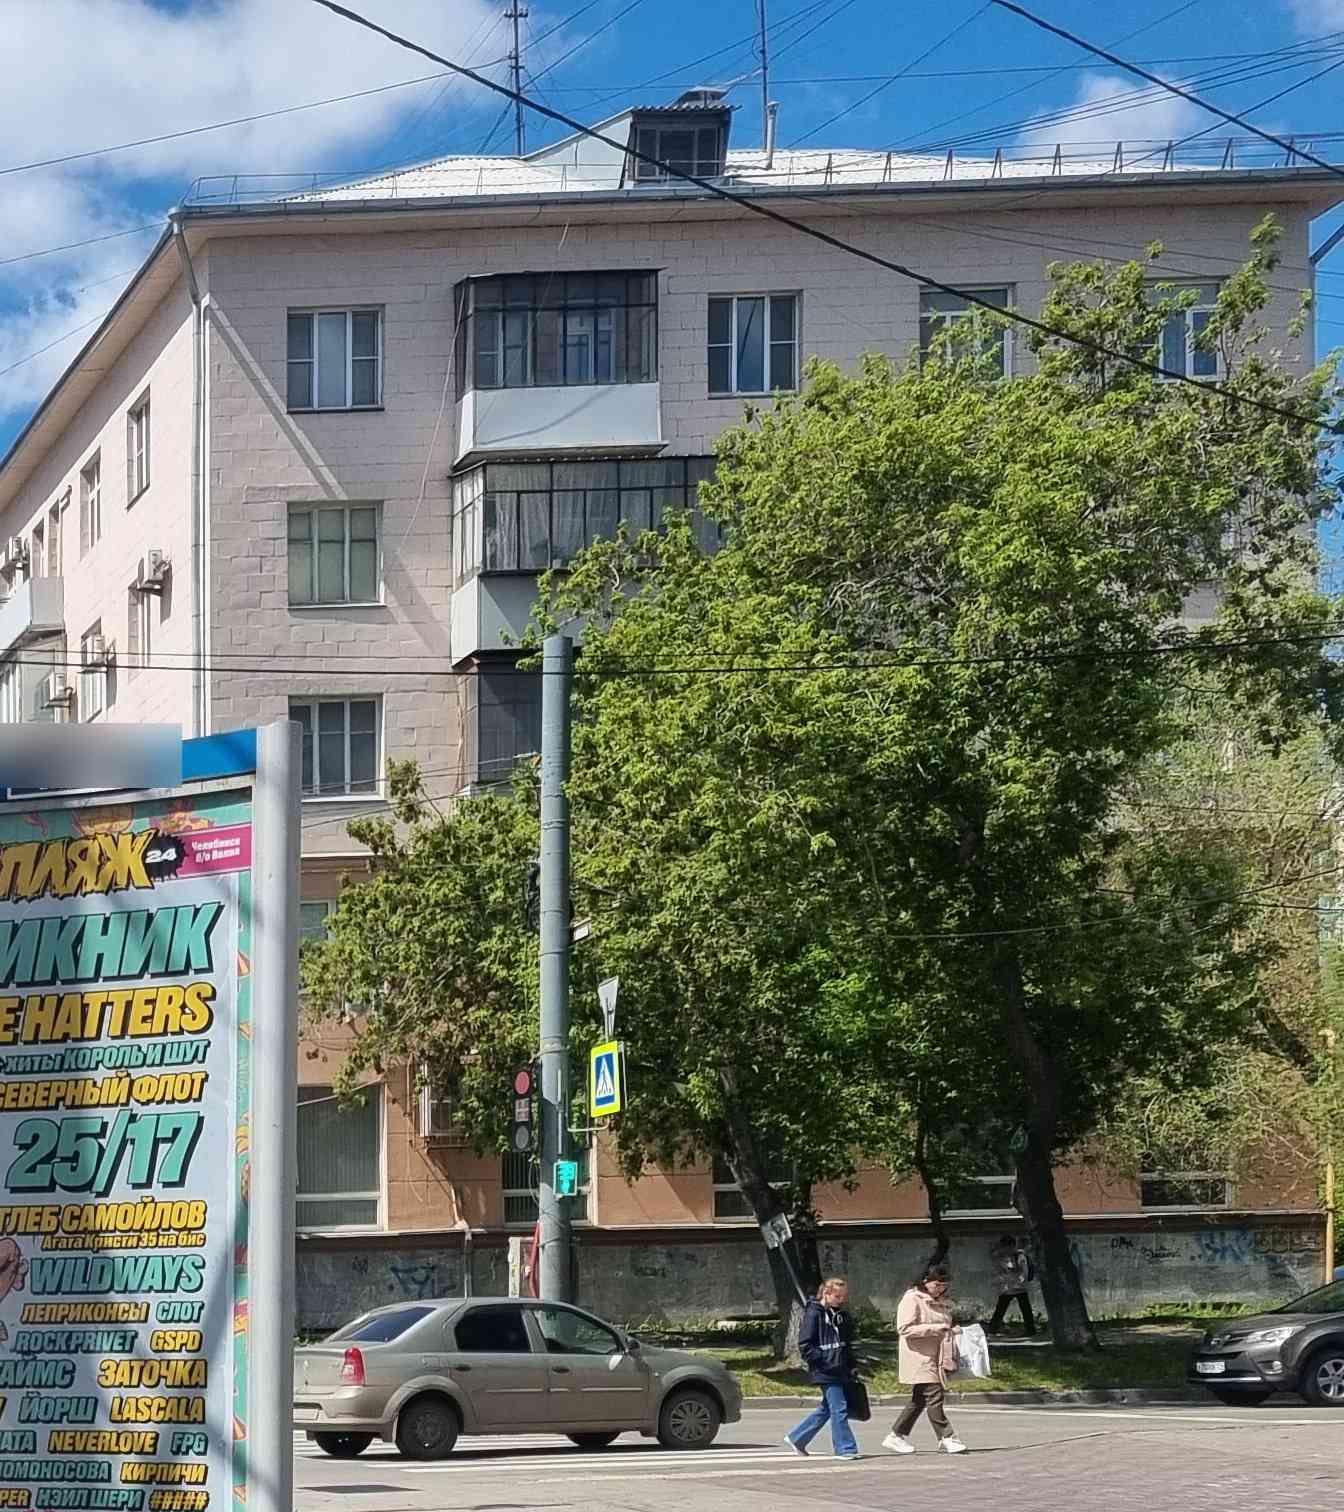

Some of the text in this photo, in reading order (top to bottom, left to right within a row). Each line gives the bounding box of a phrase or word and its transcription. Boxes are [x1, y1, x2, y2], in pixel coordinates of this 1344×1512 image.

[145, 847, 177, 864] 24
[20, 983, 216, 1044] HATTERS
[63, 1043, 146, 1071] КОРОЛЬ
[144, 1043, 164, 1066] И
[163, 1039, 210, 1065] ШУТ
[130, 1072, 208, 1104] ФЛОТ
[4, 1108, 205, 1197] 25/17
[61, 1196, 207, 1233] САМОЙЛОВ
[42, 1232, 207, 1252] Агата Кристи 35 на бис
[30, 1254, 207, 1295] WILDWAYS
[155, 1301, 204, 1323] СЛОТ
[149, 1329, 202, 1353] GSPD
[97, 1359, 208, 1388] ЗАТОЧКА
[18, 1391, 98, 1424] ЙОРШ
[109, 1396, 206, 1424] LASCALA
[48, 1430, 159, 1454] NEVERLOVE
[171, 1432, 208, 1455] FPG
[120, 1461, 209, 1484] КИРПИЧИ
